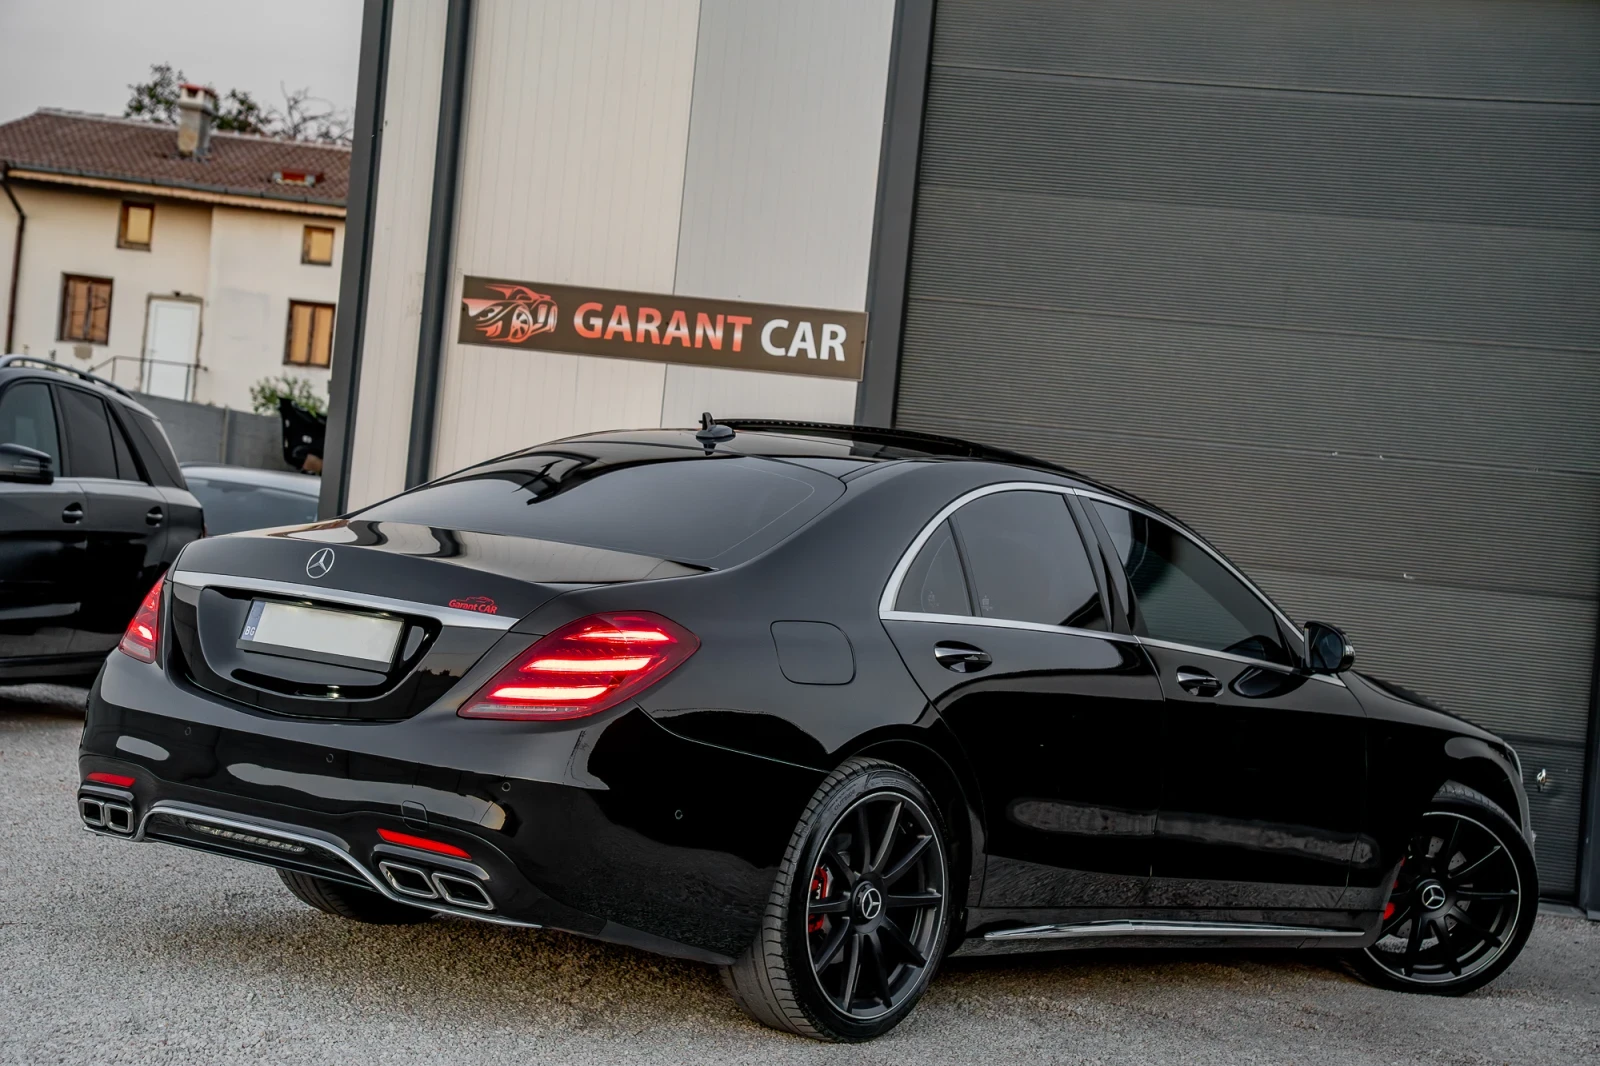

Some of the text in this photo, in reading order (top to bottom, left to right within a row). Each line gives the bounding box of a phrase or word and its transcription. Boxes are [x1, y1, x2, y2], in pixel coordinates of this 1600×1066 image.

[573, 302, 847, 361] GARANT CAR
[449, 600, 498, 614] Garant CAR
[244, 626, 256, 636] BG
